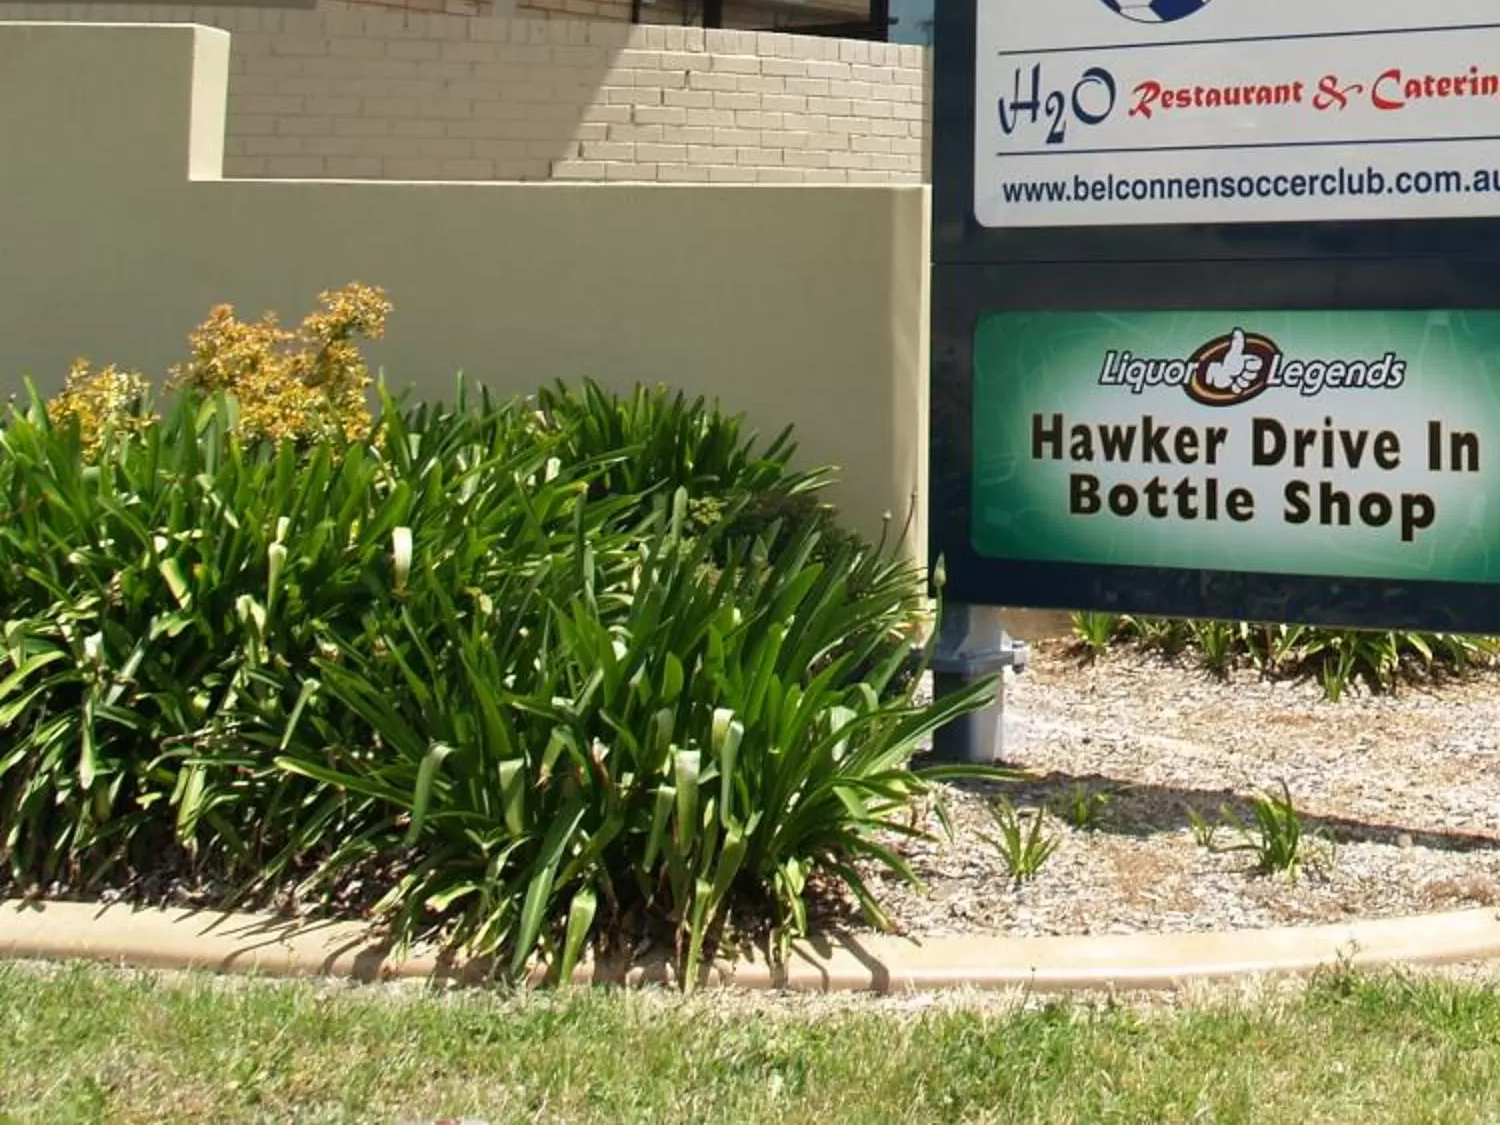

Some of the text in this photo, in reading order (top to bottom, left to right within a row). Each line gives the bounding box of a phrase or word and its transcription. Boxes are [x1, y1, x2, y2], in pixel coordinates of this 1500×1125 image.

[998, 63, 1116, 144] H2O
[1128, 79, 1302, 120] Restaurant
[1312, 75, 1362, 111] &
[1101, 351, 1406, 396] Liquor Legends
[1031, 412, 1480, 472] Hawker Drive In
[1069, 474, 1436, 542] Bottle Shop
